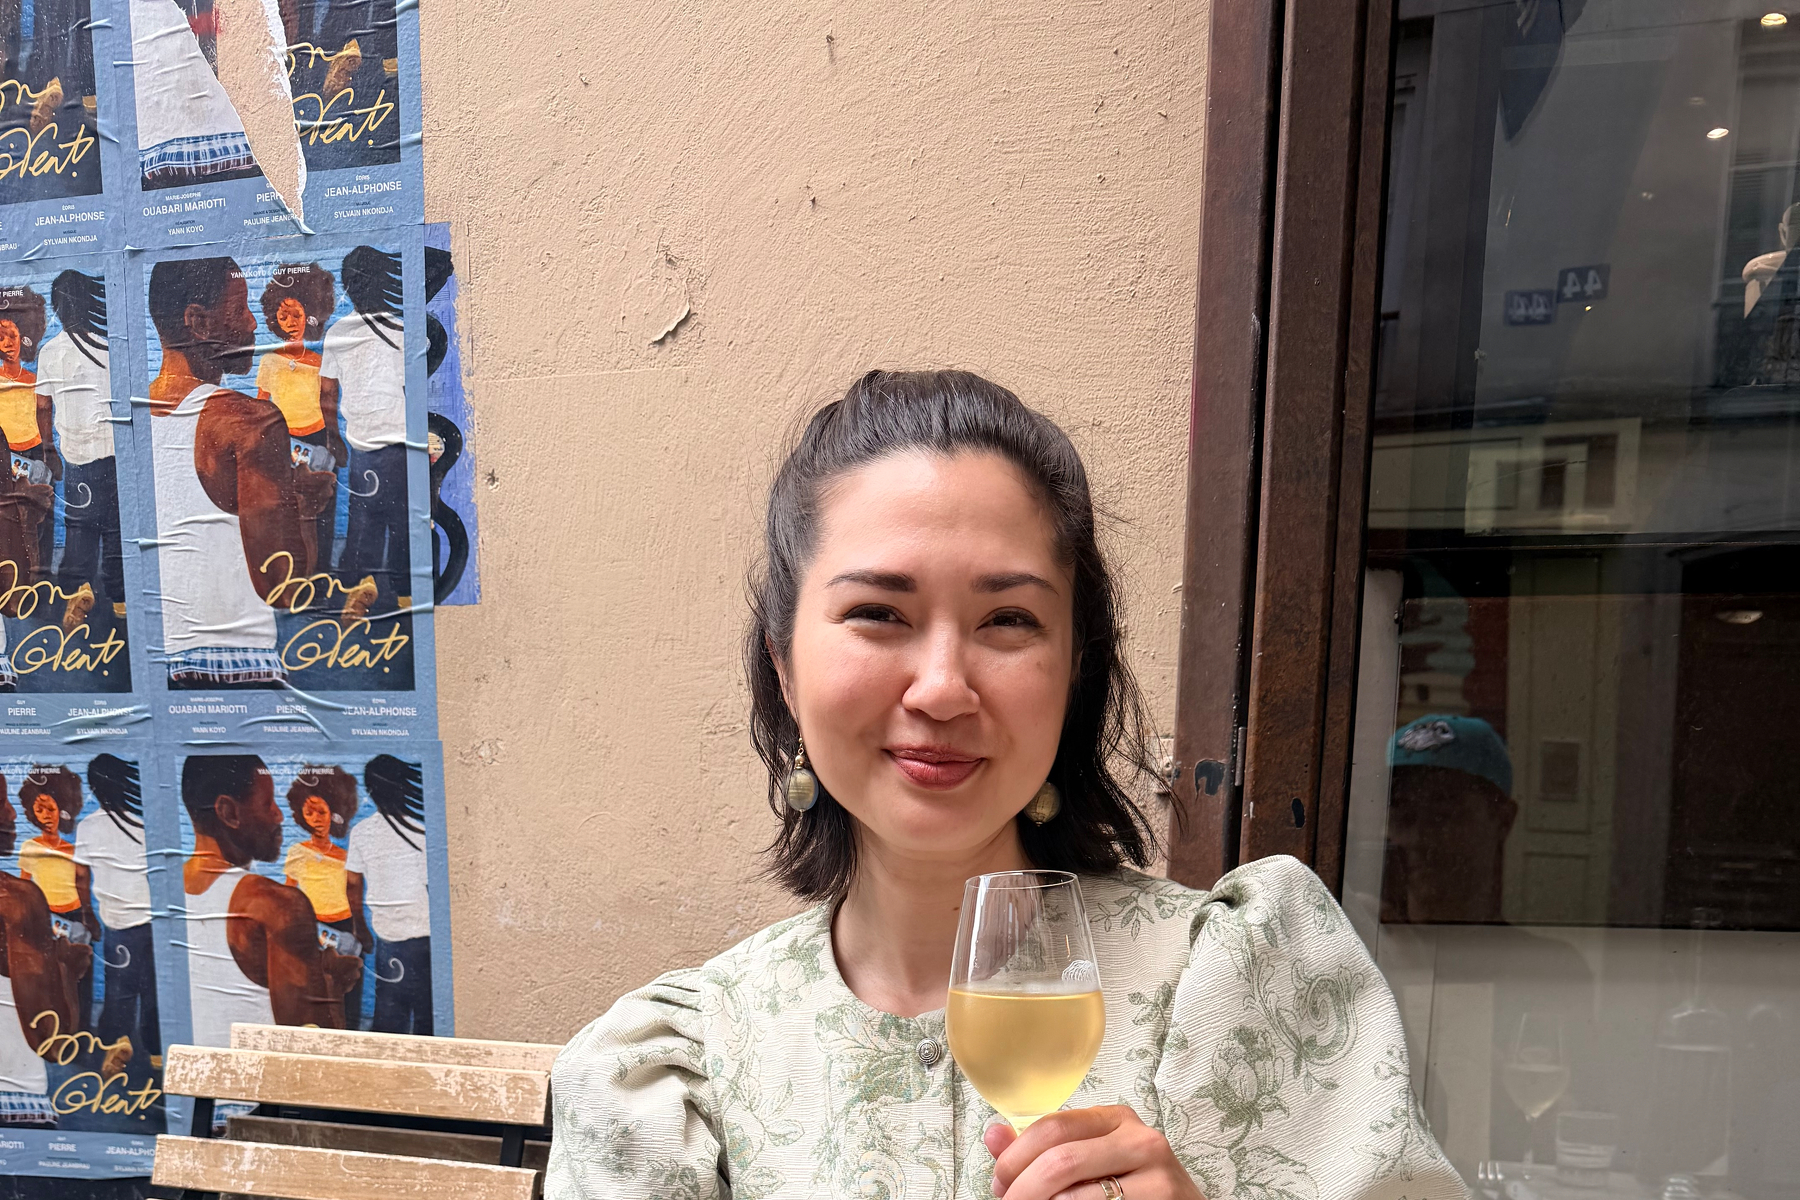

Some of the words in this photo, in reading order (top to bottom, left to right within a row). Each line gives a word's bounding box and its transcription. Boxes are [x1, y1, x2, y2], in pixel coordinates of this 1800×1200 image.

[324, 181, 402, 198] JEAN-ALPHONSE
[142, 203, 183, 217] OUABARI
[184, 198, 226, 212] MARIOTTI
[334, 208, 361, 219] SYLVAIN
[362, 206, 394, 216] NKONDJA
[35, 211, 105, 227] JEAN-ALPHONSE
[243, 216, 270, 226] PAULINE
[168, 227, 185, 236] YANN
[186, 224, 204, 234] KOYO
[44, 236, 68, 246] SYLVAIN
[69, 235, 98, 243] NKONDJA
[287, 266, 311, 274] PIERRE
[3, 289, 24, 297] PIERRE
[8, 707, 37, 716] PIERRE
[169, 705, 206, 714] OUABARI
[207, 705, 247, 714] MARIOTTI
[276, 705, 307, 714] PIERRE
[342, 707, 417, 716] JEAN-ALPHONSE
